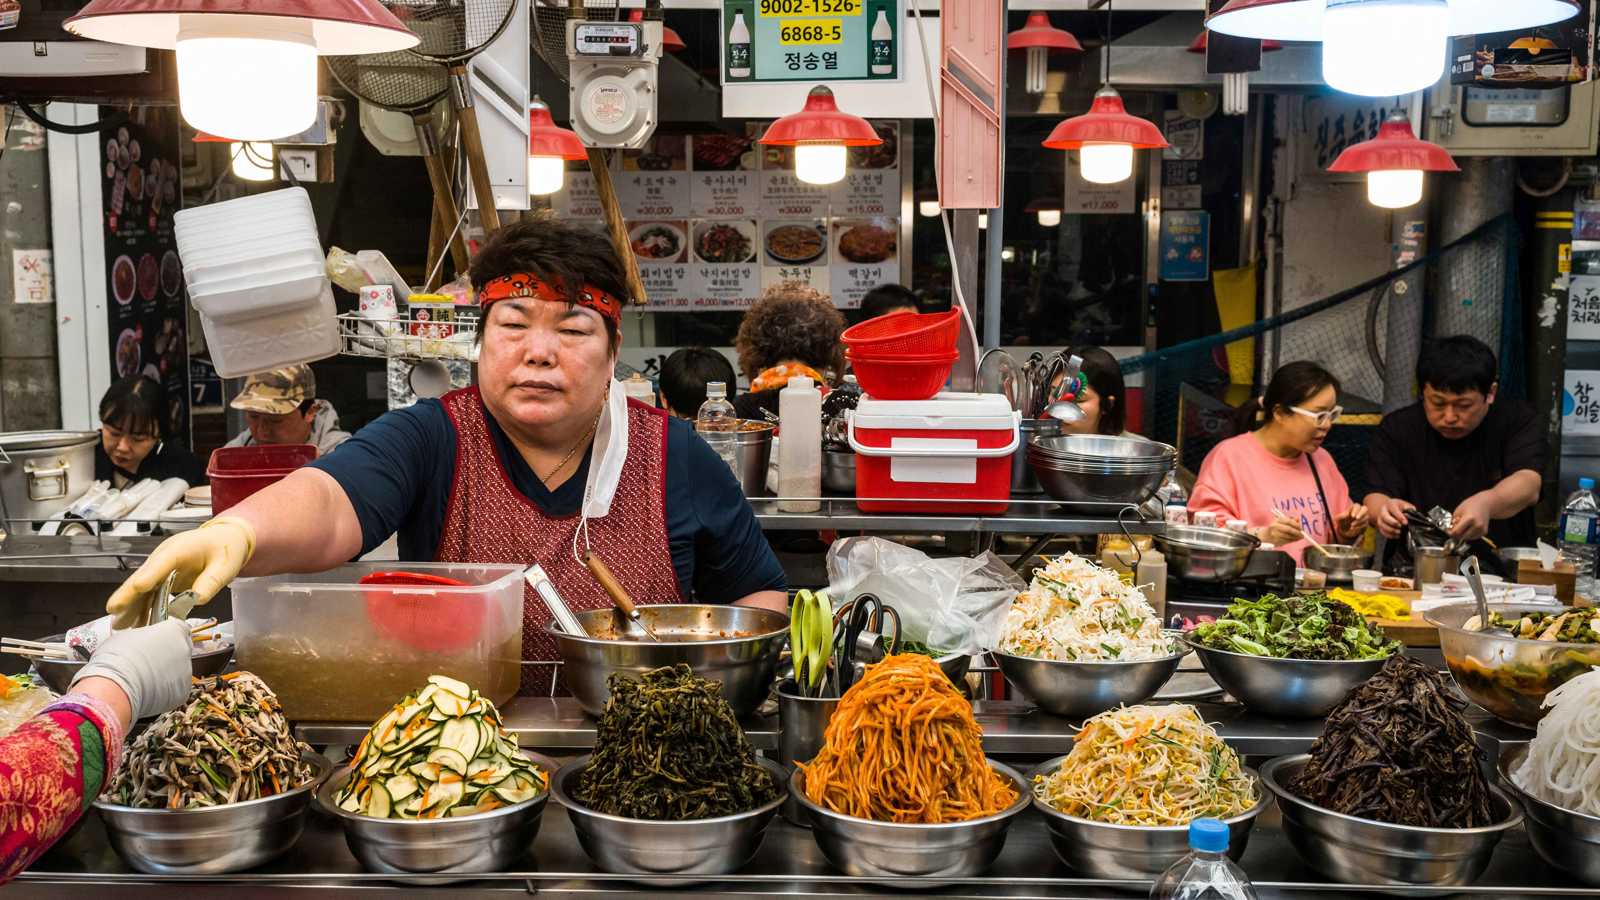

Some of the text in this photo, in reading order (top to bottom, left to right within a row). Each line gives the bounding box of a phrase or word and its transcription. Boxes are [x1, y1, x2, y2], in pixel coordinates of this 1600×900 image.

[781, 26, 841, 42] 6868-5
[784, 51, 838, 71] 정송열
[1574, 381, 1595, 404] 참
[1575, 400, 1600, 424] 이슬
